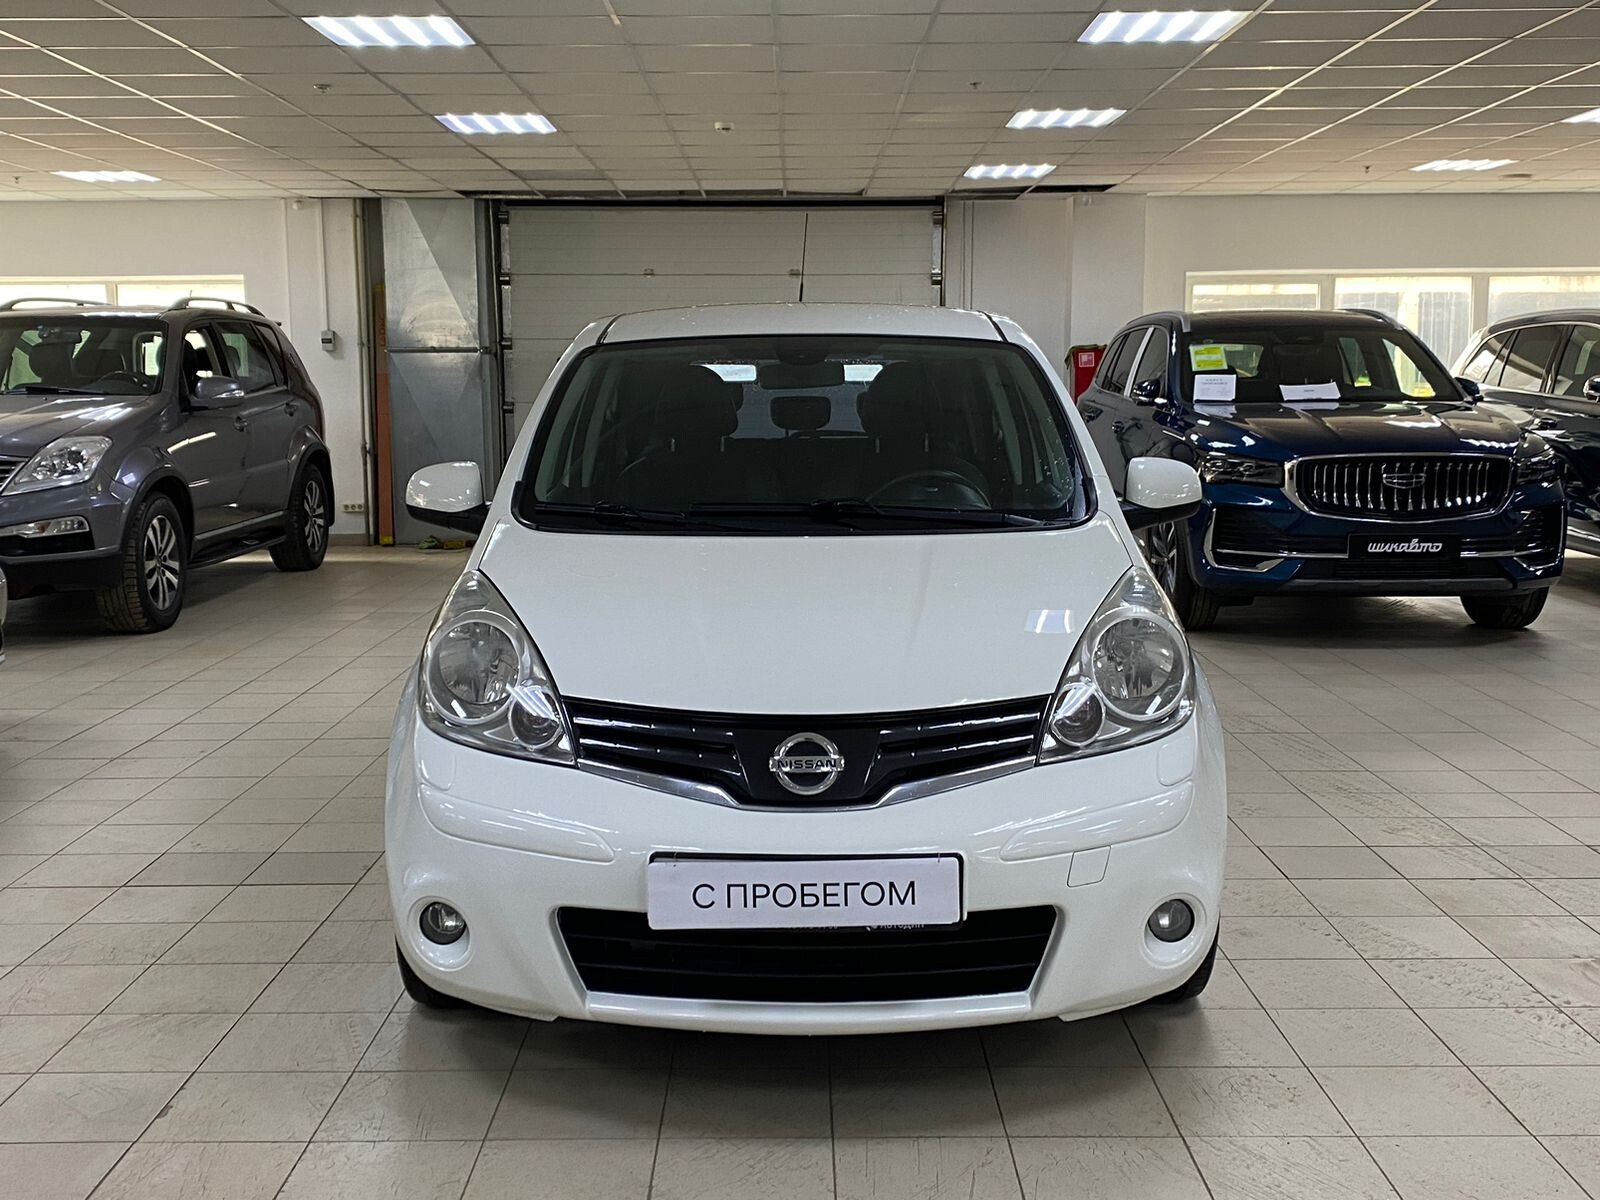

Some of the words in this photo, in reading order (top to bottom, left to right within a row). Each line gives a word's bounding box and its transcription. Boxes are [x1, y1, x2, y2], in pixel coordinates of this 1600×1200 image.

[776, 758, 837, 770] NISSAN
[692, 883, 716, 909] С
[727, 880, 916, 908] ПРОБЕГОМ
